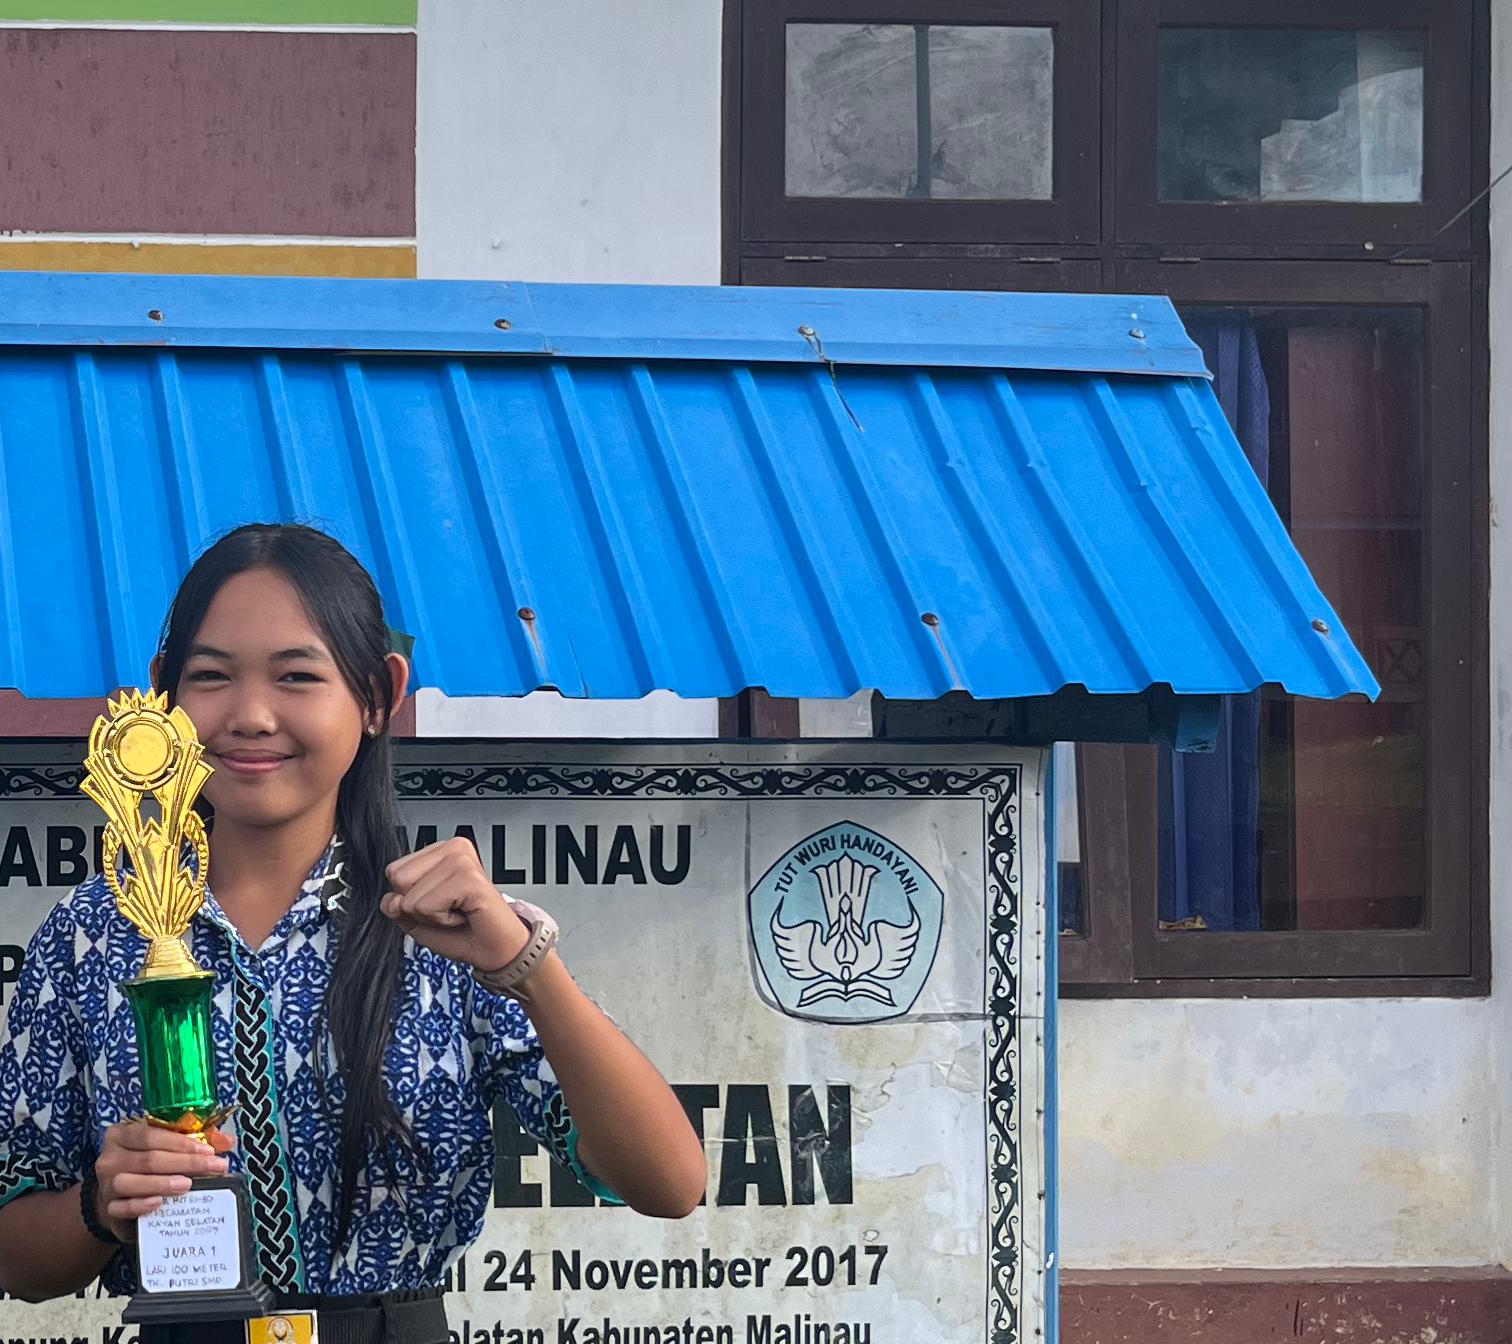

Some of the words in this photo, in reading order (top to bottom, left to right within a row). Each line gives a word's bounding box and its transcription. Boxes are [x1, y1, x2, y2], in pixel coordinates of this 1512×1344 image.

[774, 862, 799, 894] TUT
[793, 835, 837, 866] WURI
[840, 833, 919, 896] HANDAYANI
[185, 1216, 225, 1226] SELATAN
[162, 1246, 206, 1259] JUARA
[211, 1245, 217, 1257] 1
[146, 1265, 167, 1275] LARI
[171, 1264, 189, 1275] 100
[193, 1263, 228, 1273] METER
[483, 1249, 537, 1292] 24
[552, 1247, 772, 1292] November
[784, 1244, 889, 1288] 2017
[169, 1277, 199, 1288] PUTRI
